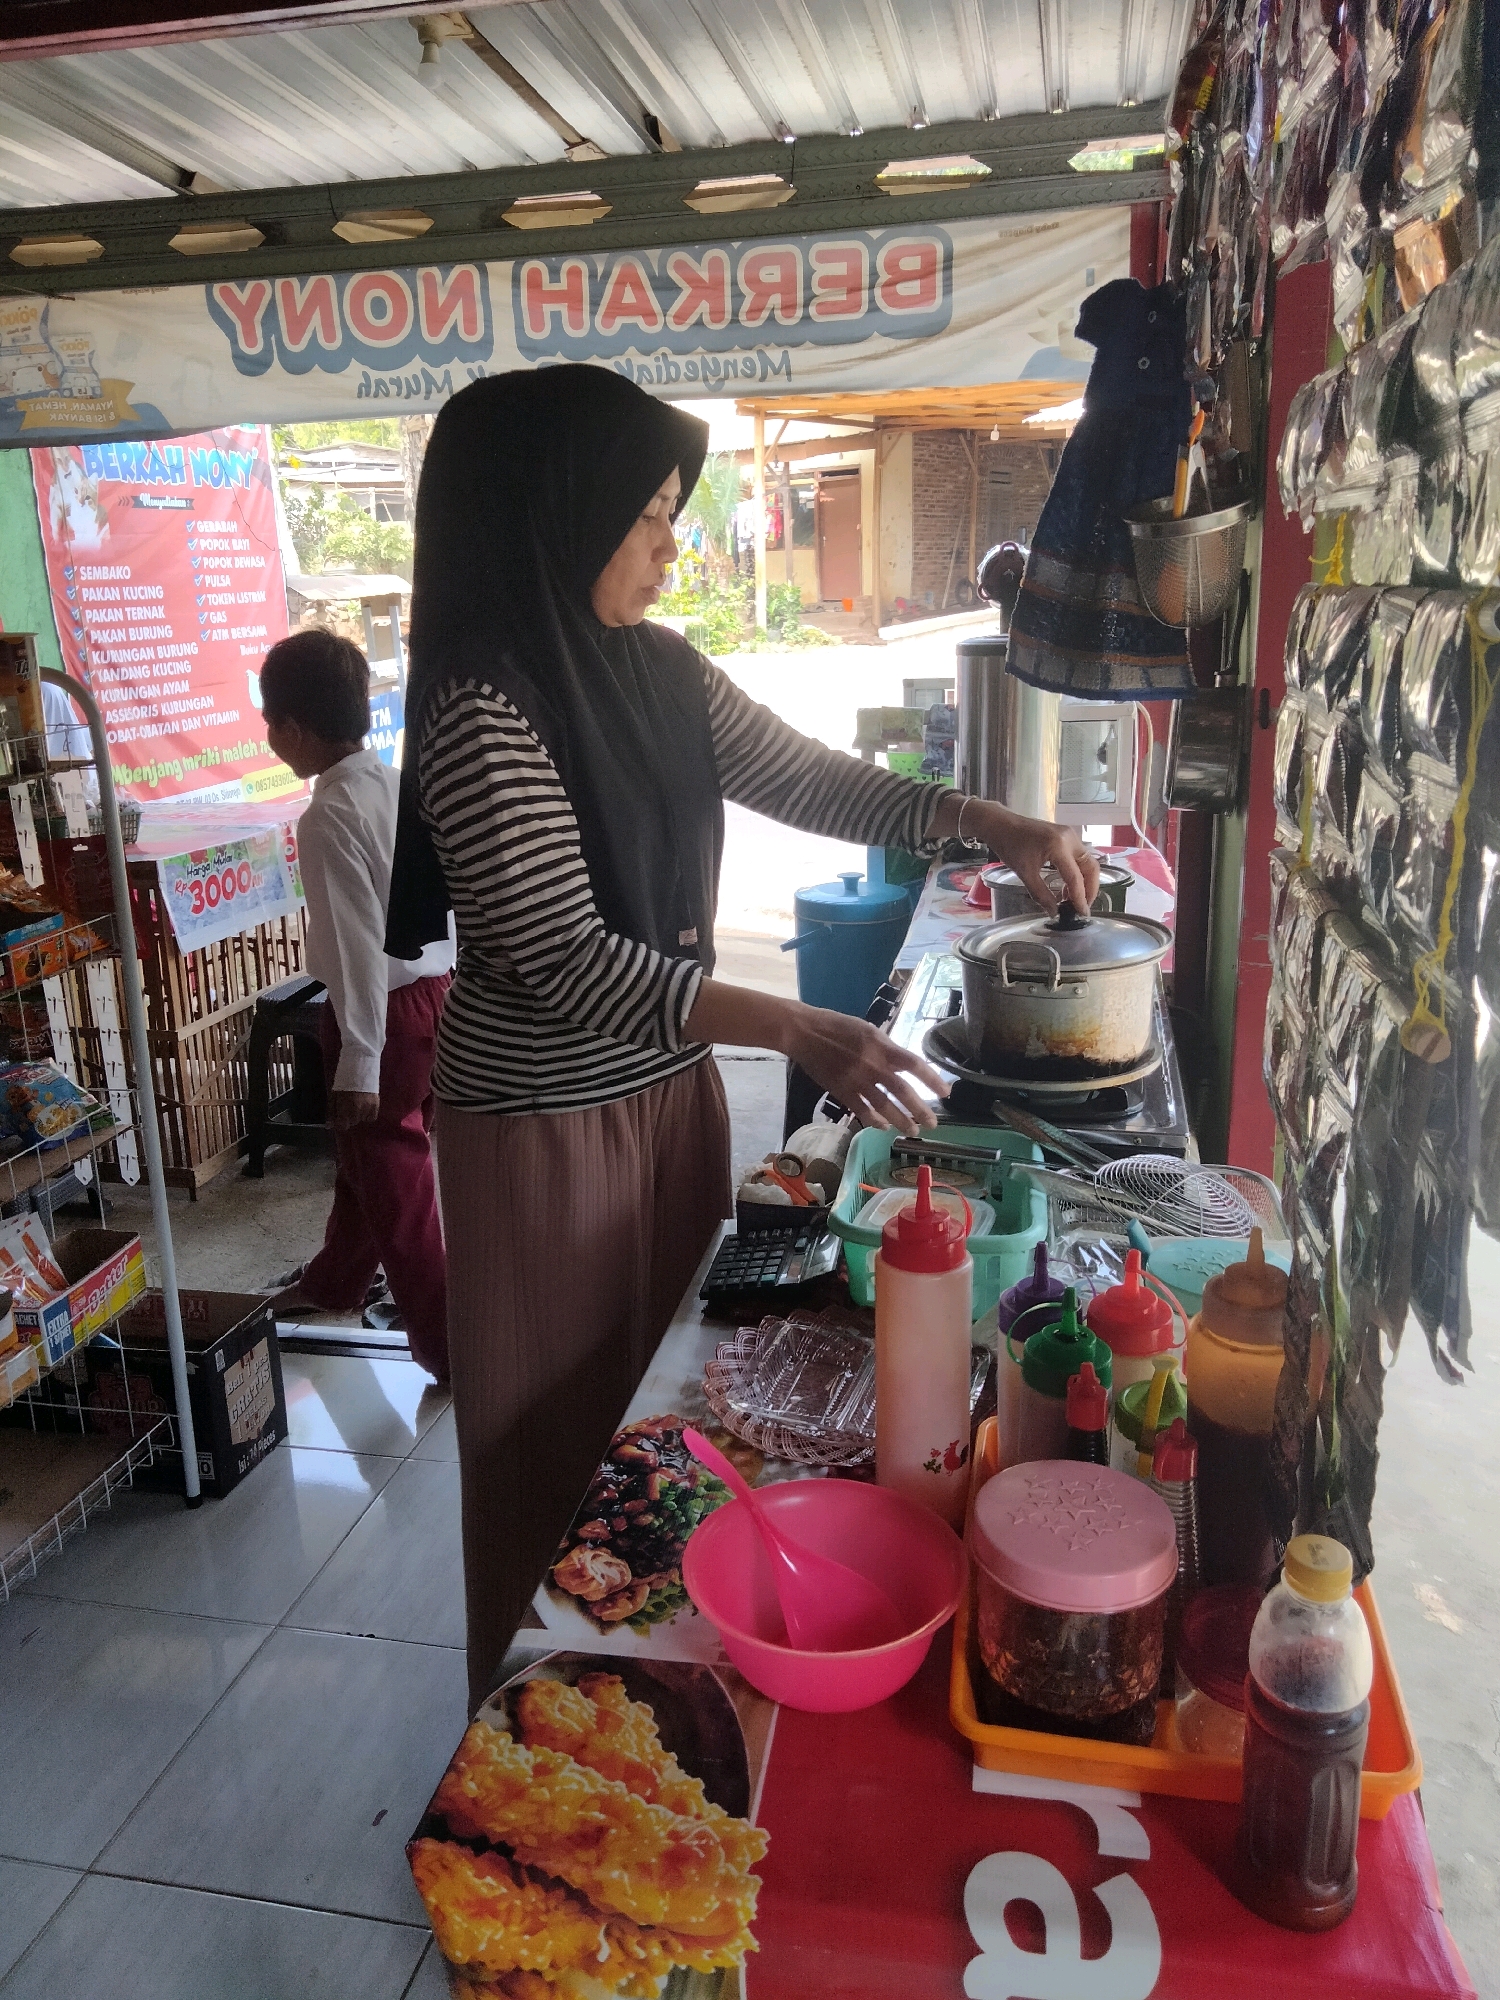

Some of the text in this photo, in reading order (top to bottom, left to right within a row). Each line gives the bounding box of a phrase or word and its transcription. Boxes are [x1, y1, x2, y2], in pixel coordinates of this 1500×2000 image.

[79, 442, 258, 490] BERKAH NONY
[200, 538, 250, 550] POPOK BAYI
[203, 556, 266, 569] POPOK DEWASA
[80, 566, 131, 580] SEMBAKO
[204, 575, 231, 587] PULSA
[82, 585, 164, 602] PAKAN KUCING
[206, 593, 236, 605] TOKEN
[85, 605, 165, 623] PAKAN TERNAK
[209, 611, 228, 624] GAS
[90, 625, 173, 644] PAKAN BURUNG
[211, 625, 268, 641] ATM BERSAMA
[91, 642, 199, 665] KURUNGAN BURUNG
[152, 660, 192, 677] KUCING
[100, 680, 190, 704] KURUNGAN AYAM
[161, 695, 215, 716] KURUNGAN
[107, 709, 240, 744] OBAT-OBATAN DAN VITAMIN
[371, 706, 392, 729] TM
[111, 758, 184, 788] Mbenjang
[182, 745, 220, 770] mriki
[222, 738, 258, 763] maleh
[186, 853, 233, 877] Harga Mulai
[175, 879, 188, 897] Rp
[15, 1313, 38, 1327] ACHET
[47, 1311, 69, 1336] EXTRA
[230, 1363, 271, 1426] GRATIS
